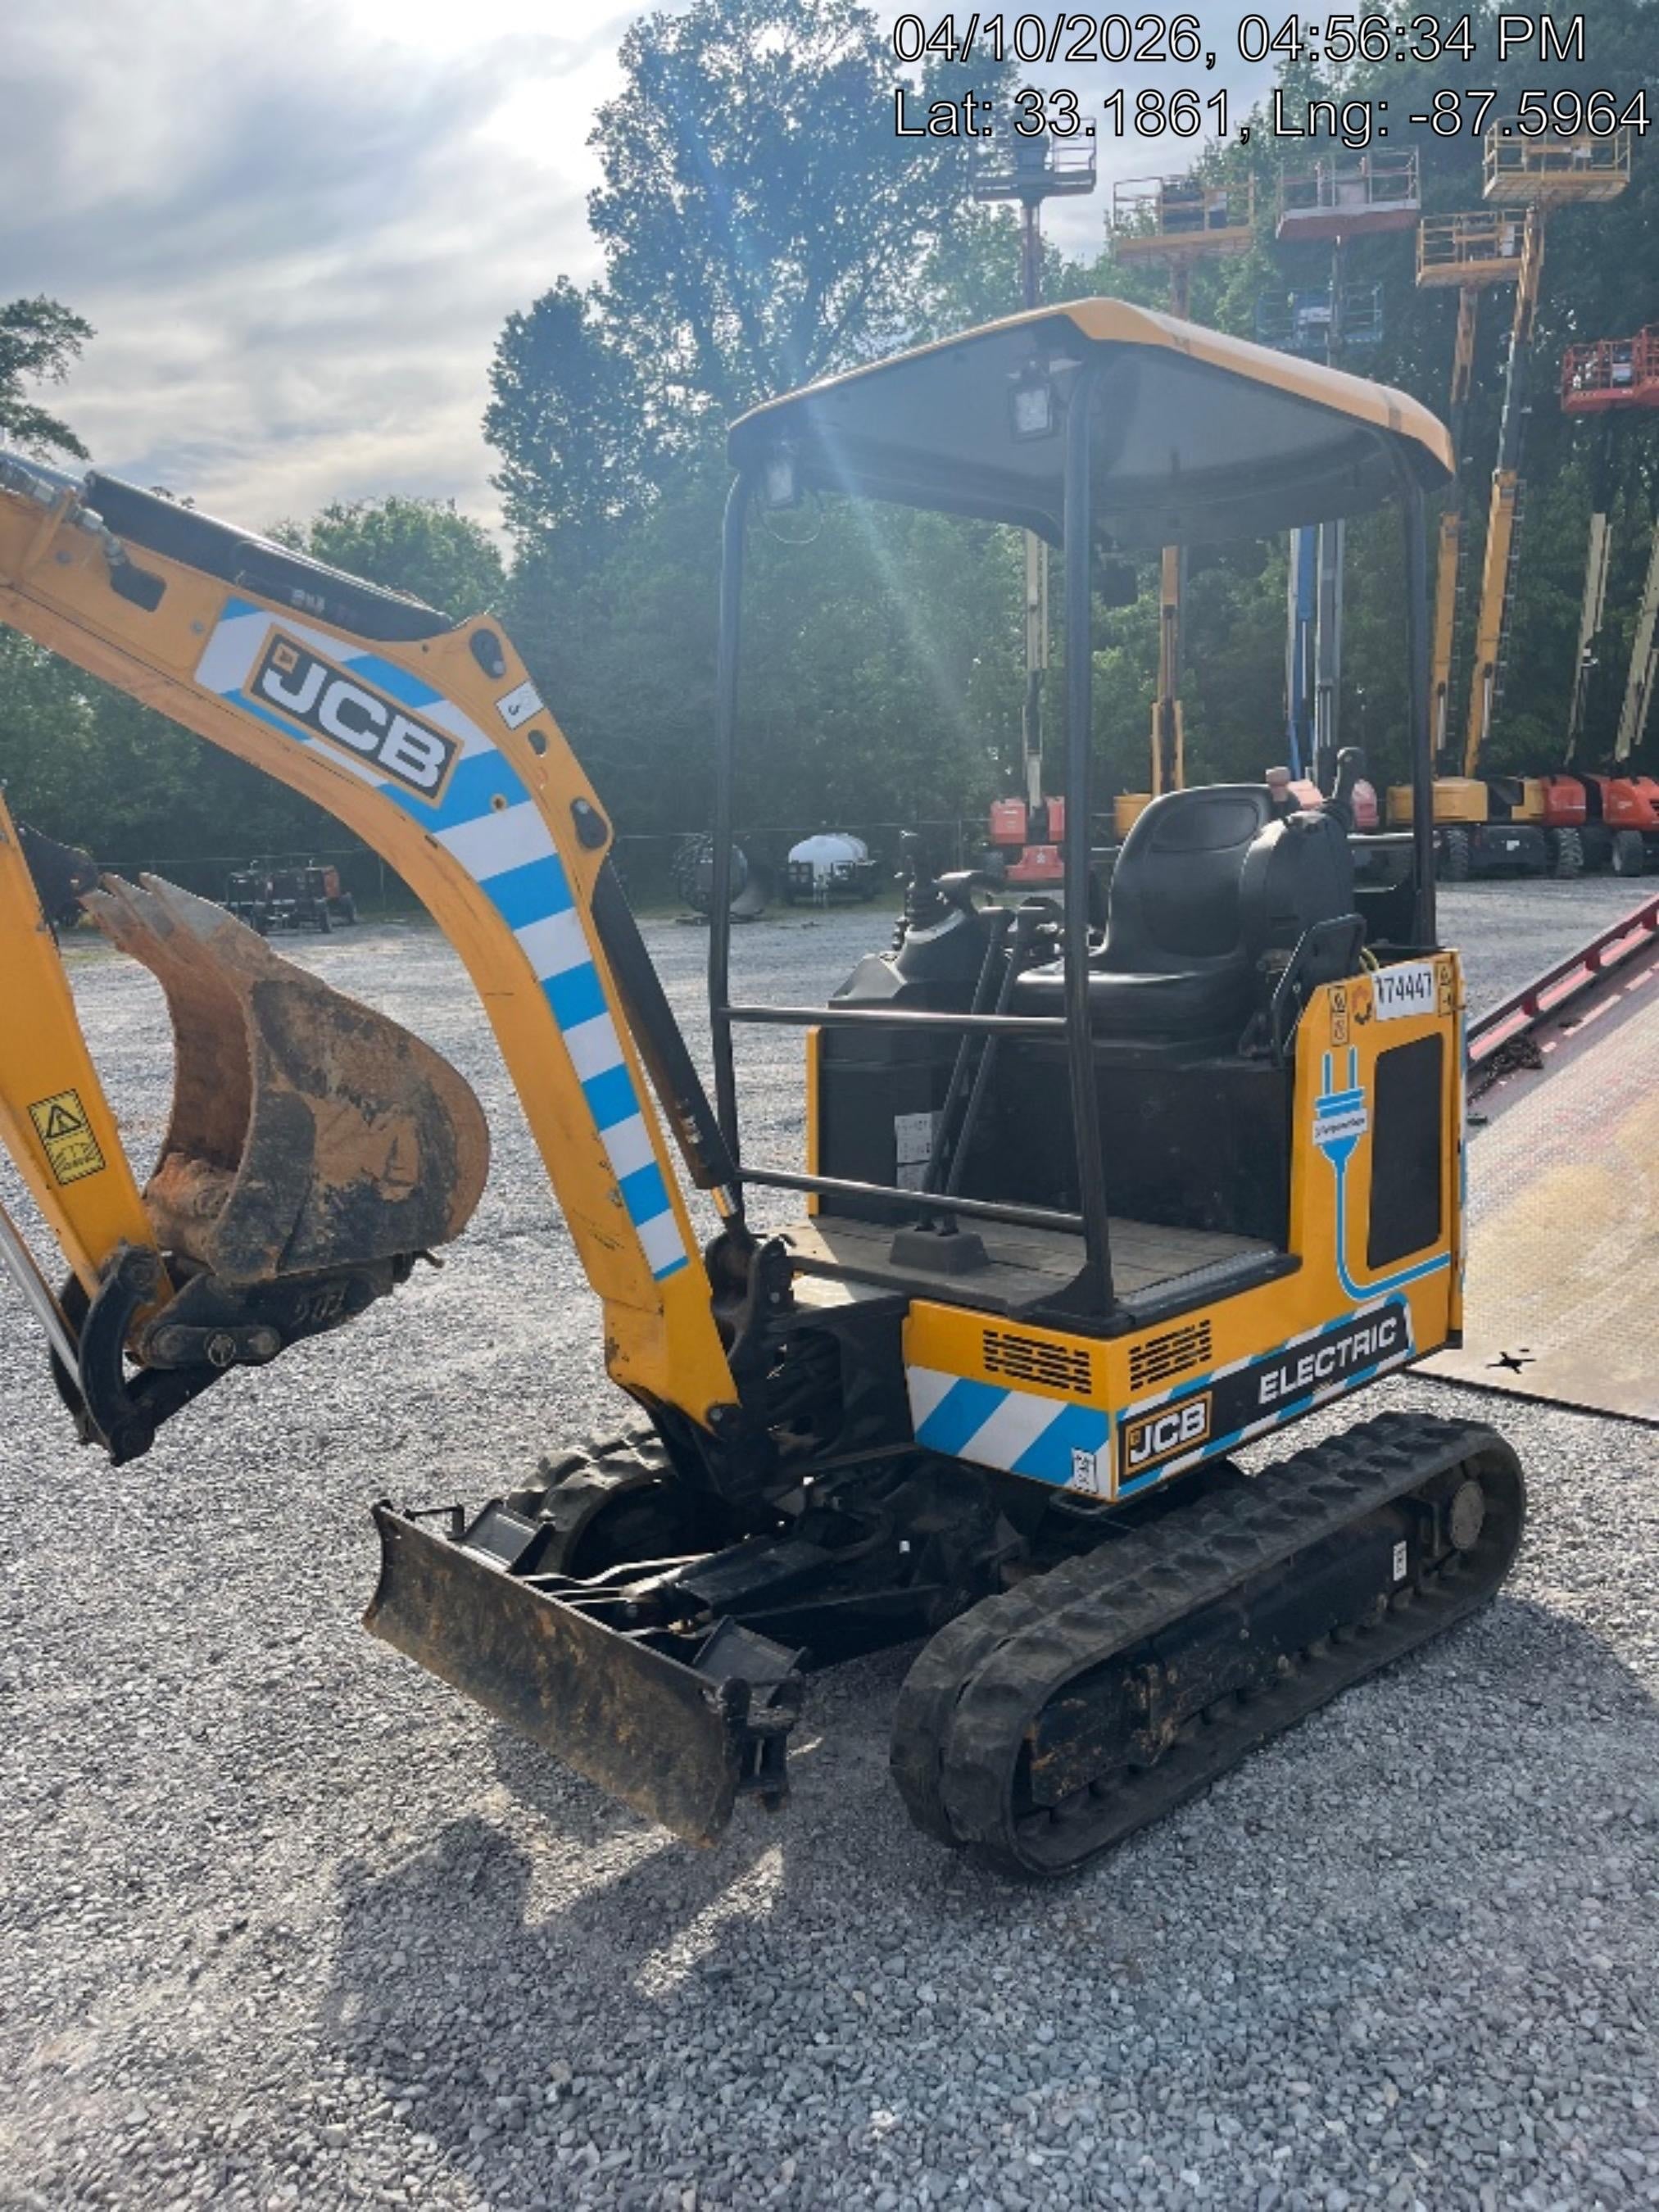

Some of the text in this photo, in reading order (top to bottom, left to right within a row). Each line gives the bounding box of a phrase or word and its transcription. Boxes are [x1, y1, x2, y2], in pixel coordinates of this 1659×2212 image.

[261, 662, 446, 788] JCB
[1130, 1316, 1397, 1465] JCB ELECTRIC
